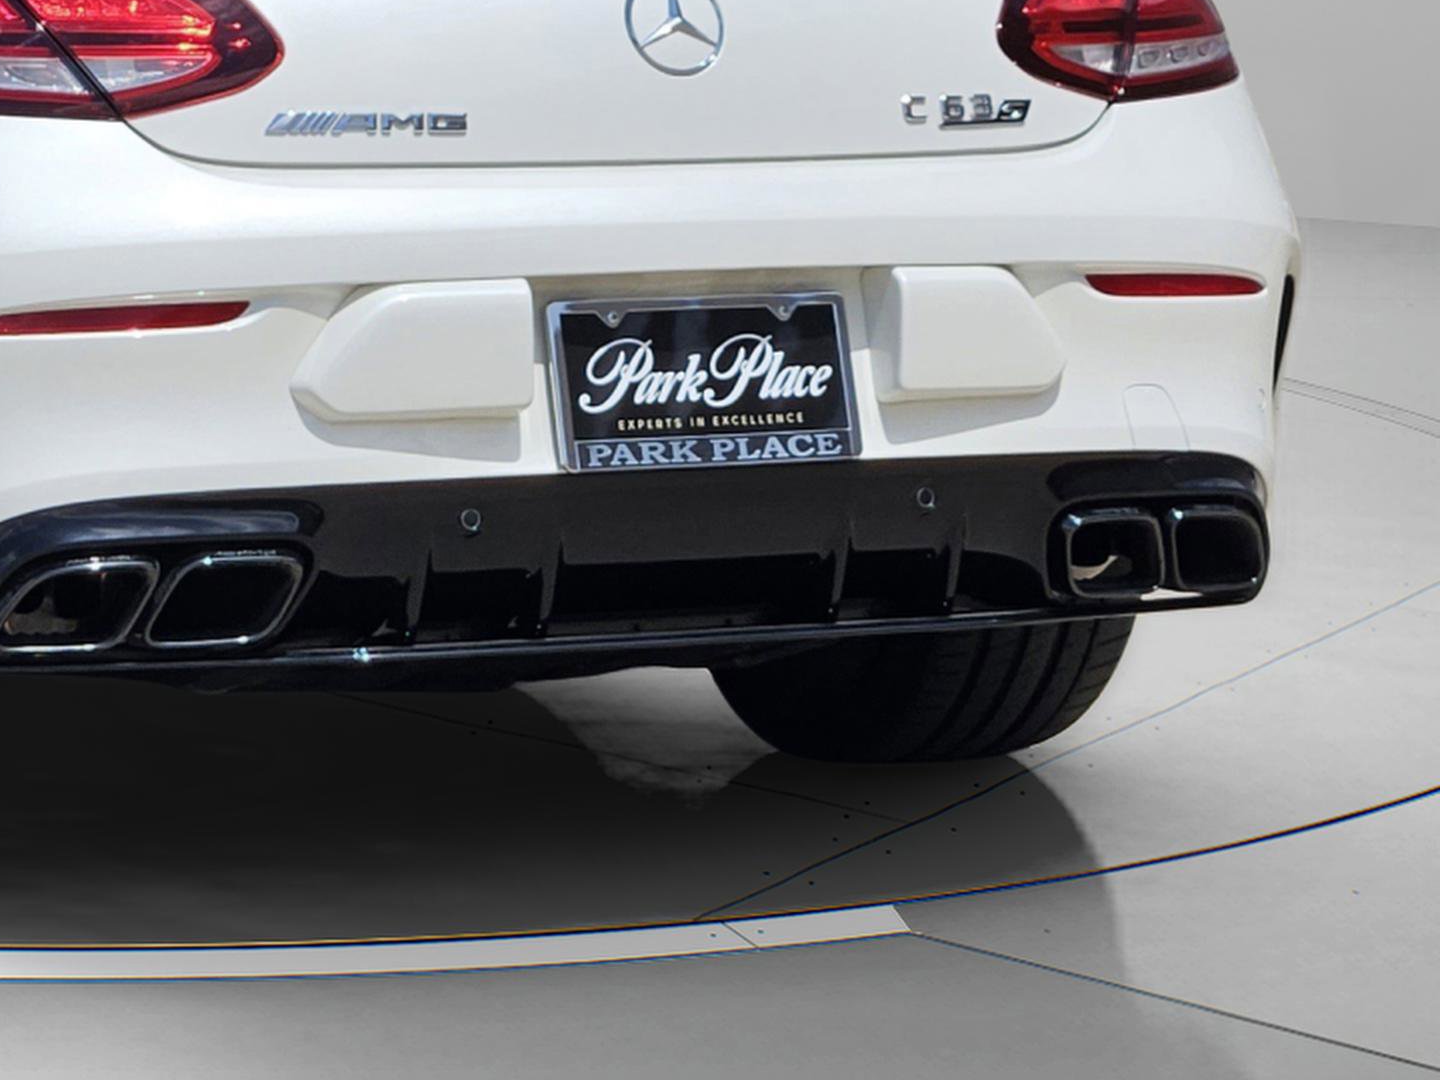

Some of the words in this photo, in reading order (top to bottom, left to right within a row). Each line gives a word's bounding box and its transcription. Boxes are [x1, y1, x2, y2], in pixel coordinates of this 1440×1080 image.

[900, 94, 927, 122] C
[330, 112, 468, 134] AMG
[578, 338, 708, 413] Park
[705, 333, 833, 407] Place
[617, 418, 682, 431] EXPERTS
[690, 416, 705, 427] IN
[712, 412, 804, 427] EXCELLENCE
[587, 441, 702, 467] PARK
[710, 433, 842, 462] PLACE
